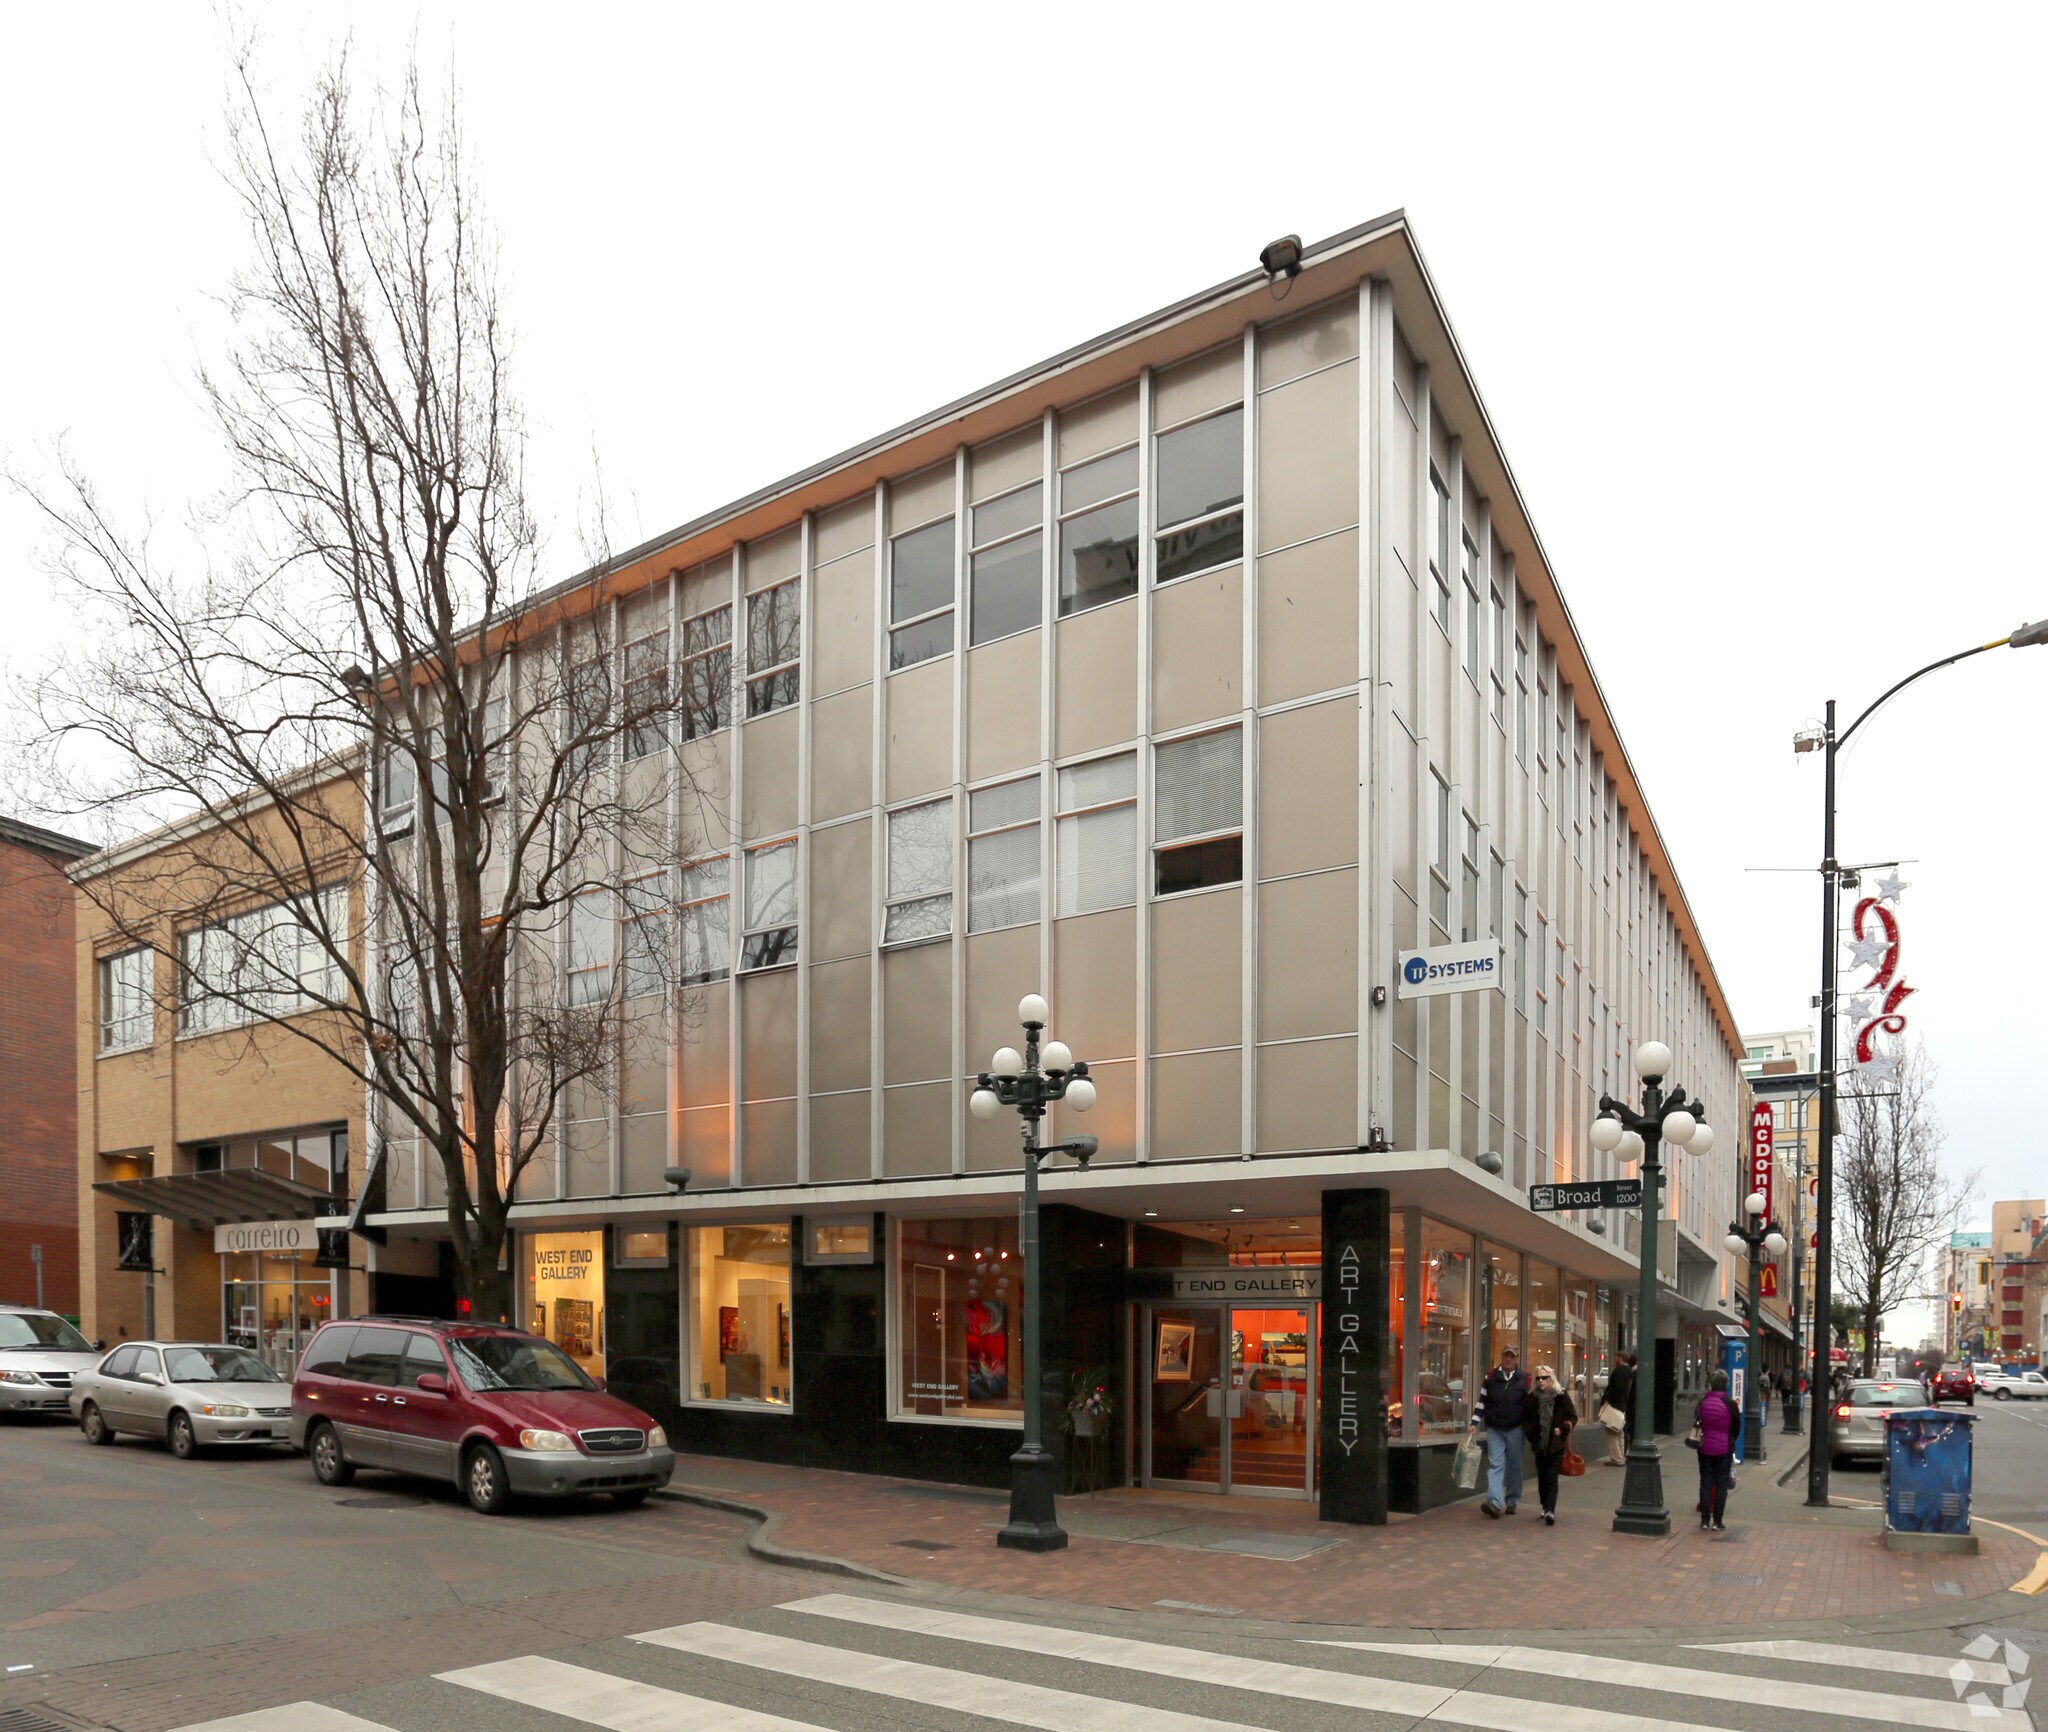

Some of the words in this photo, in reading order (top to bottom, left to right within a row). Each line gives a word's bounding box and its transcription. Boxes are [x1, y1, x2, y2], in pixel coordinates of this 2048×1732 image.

[1429, 957, 1494, 978] SYSTEMS
[1753, 1112, 1772, 1236] McDona
[1557, 1187, 1601, 1205] Broad
[1616, 1193, 1637, 1204] 1200
[227, 1225, 300, 1250] carreiro
[535, 1250, 567, 1265] WEST
[569, 1249, 593, 1263] END
[541, 1265, 588, 1280] GALLERY
[1339, 1245, 1360, 1305] ART
[1190, 1280, 1226, 1291] END
[1234, 1279, 1318, 1291] GALLERY
[1735, 1350, 1742, 1362] P
[1339, 1314, 1360, 1457] GALLERY
